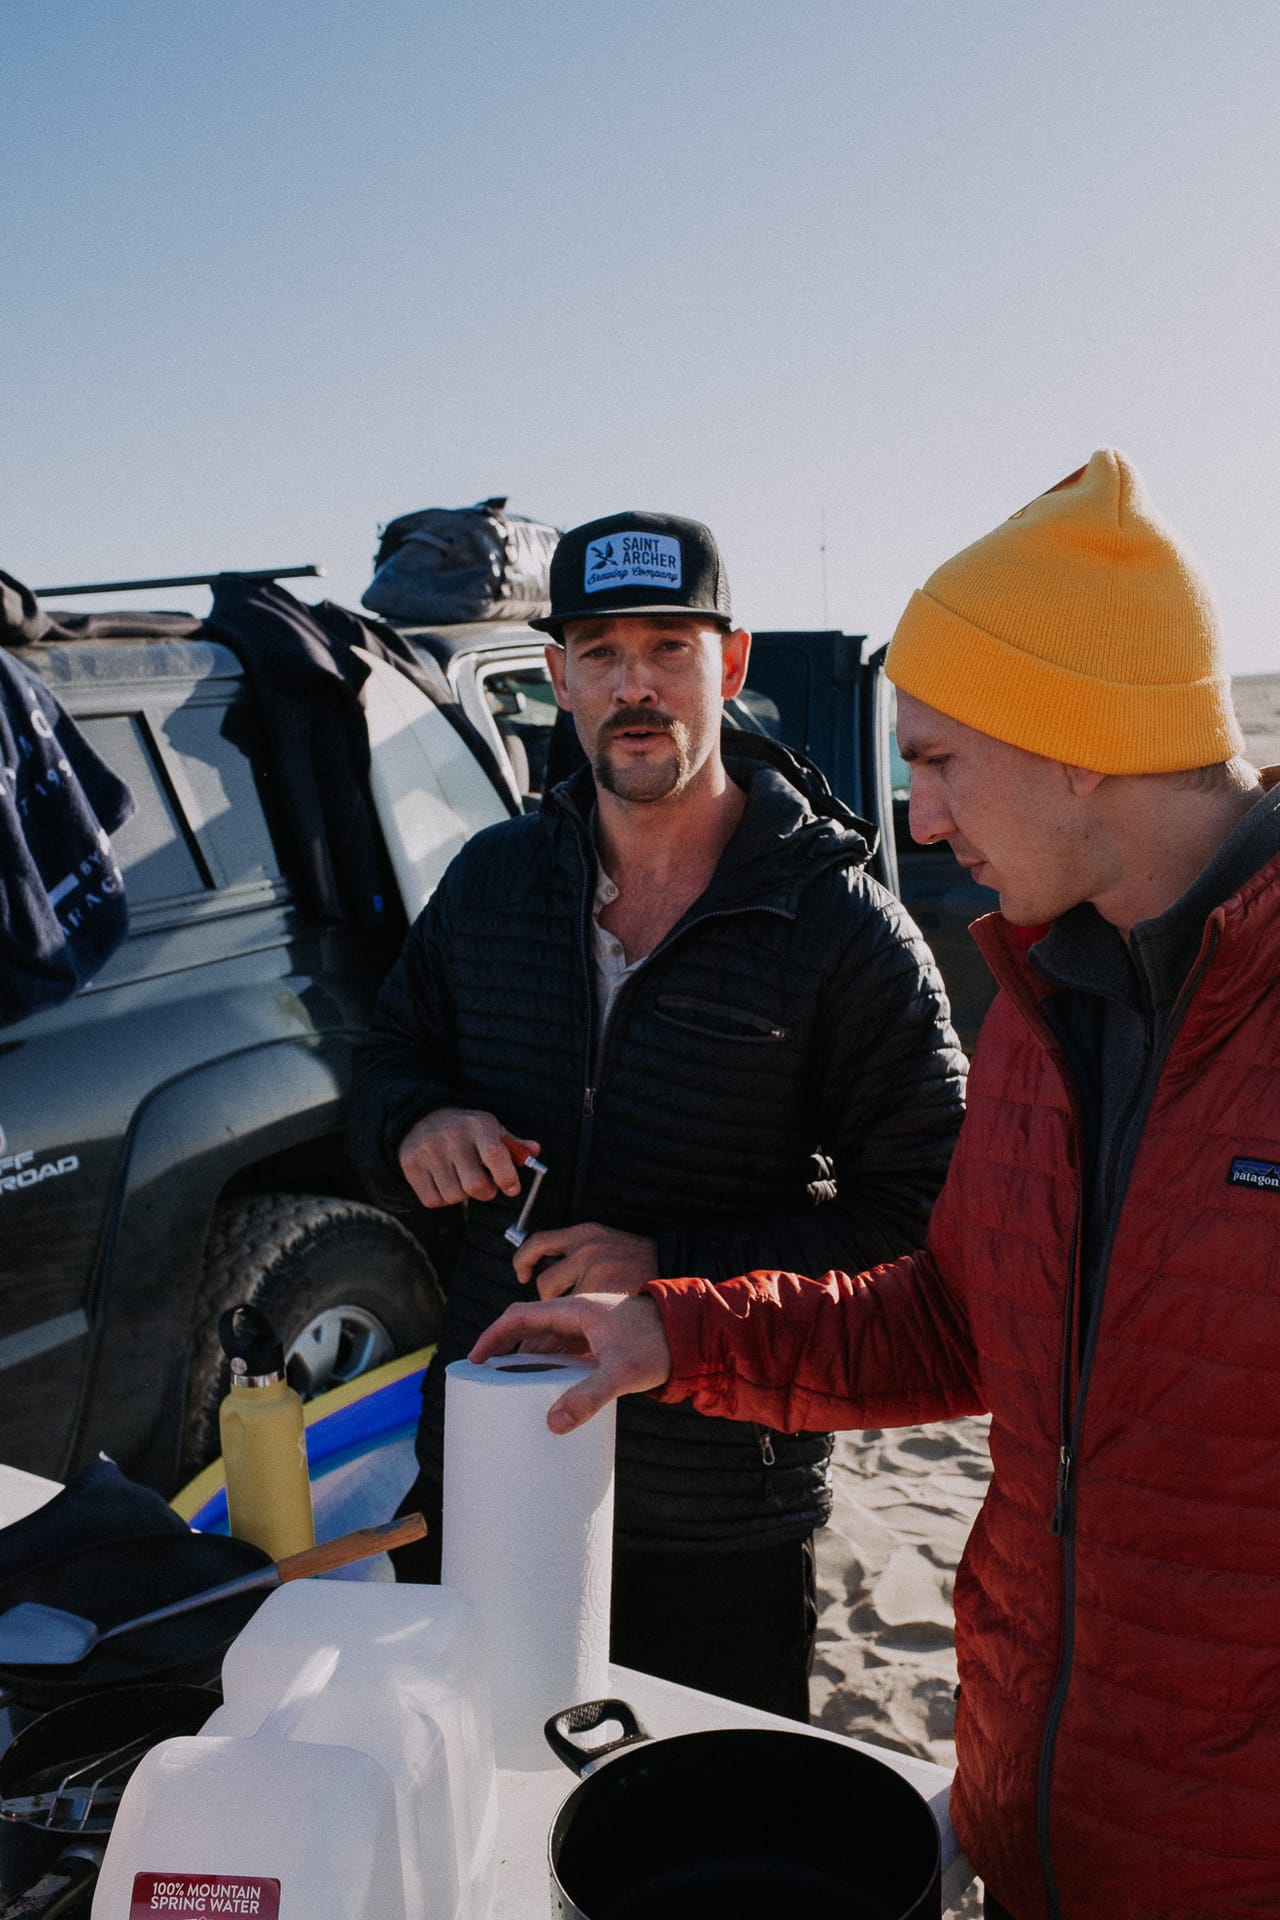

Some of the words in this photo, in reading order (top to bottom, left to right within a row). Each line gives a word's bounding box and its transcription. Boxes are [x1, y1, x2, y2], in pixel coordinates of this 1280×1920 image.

[622, 537, 661, 552] SAINT
[622, 551, 677, 569] ARCHER
[587, 568, 629, 586] Brewing
[631, 566, 679, 583] Company
[0, 1154, 80, 1196] ROAD
[152, 1882, 185, 1897] 100%
[186, 1883, 261, 1900] MOUNTAIN
[150, 1895, 206, 1911] SPRING
[210, 1898, 260, 1914] WATER
